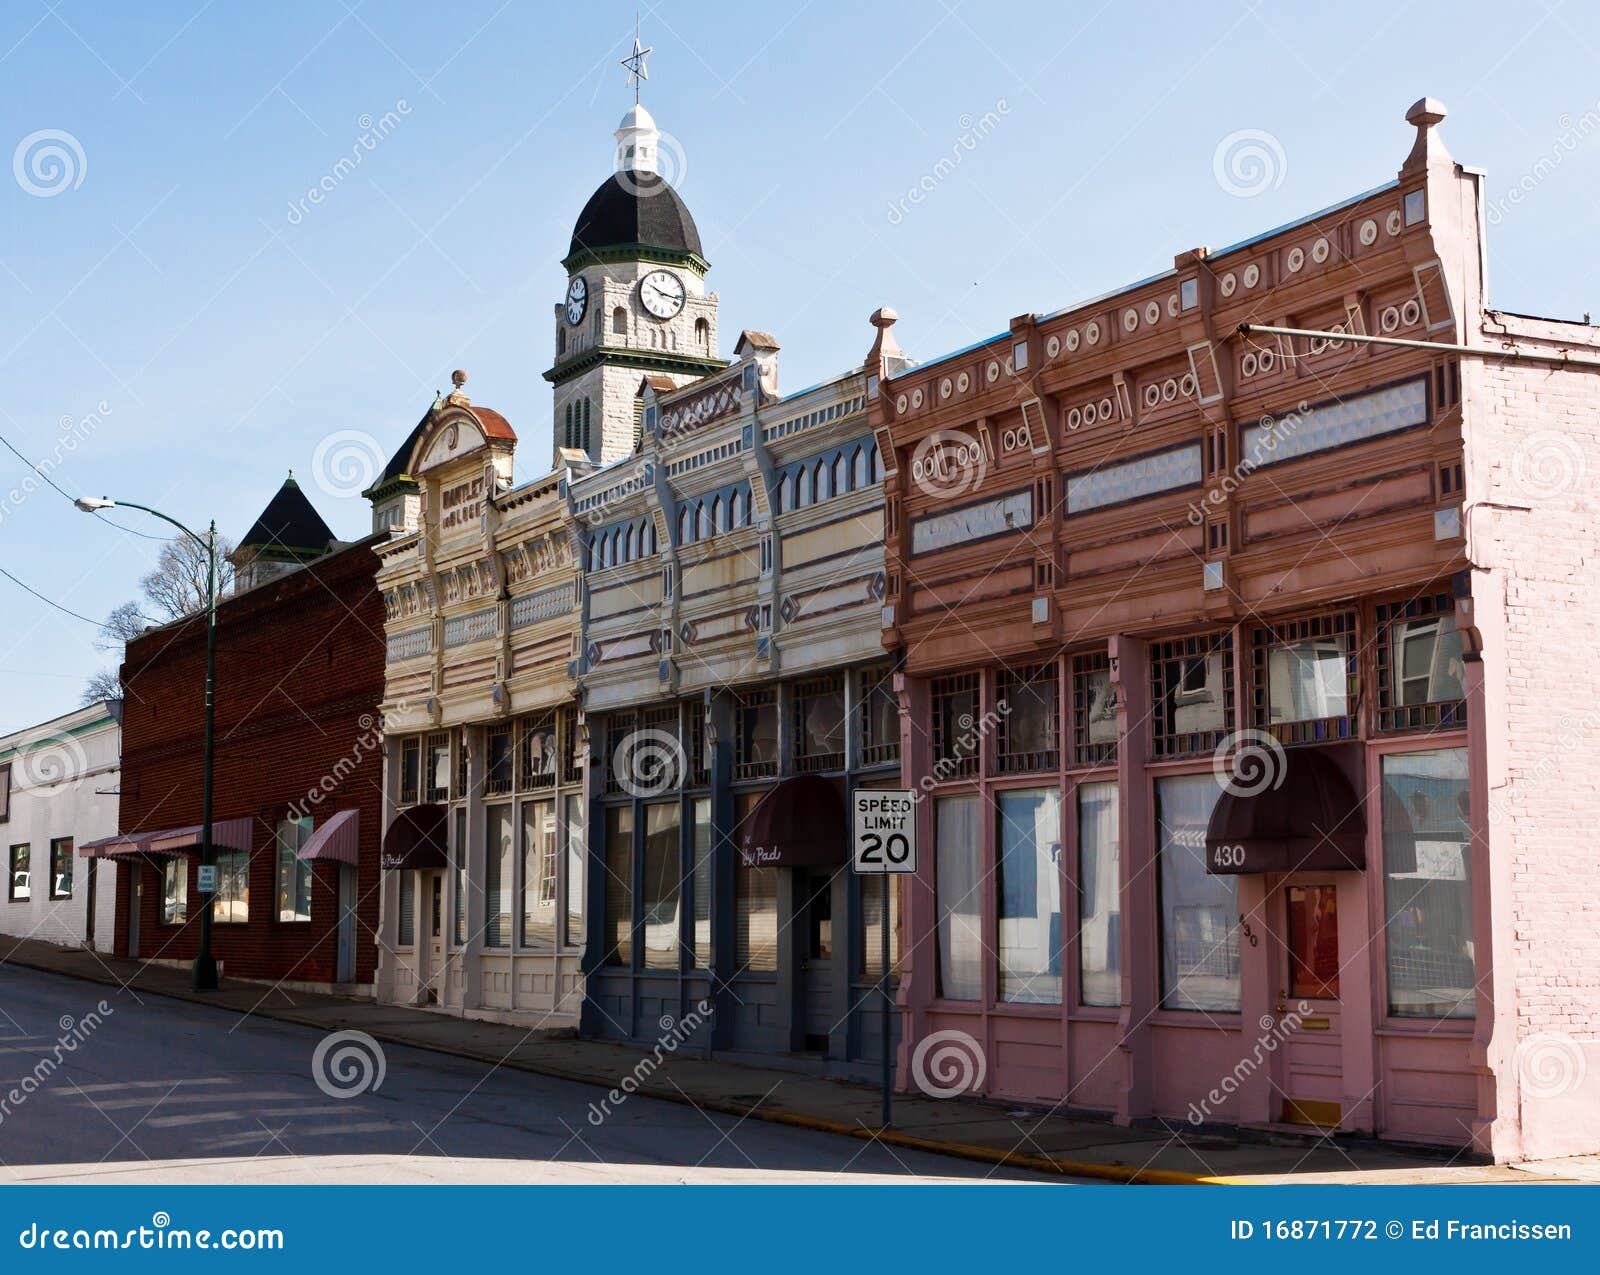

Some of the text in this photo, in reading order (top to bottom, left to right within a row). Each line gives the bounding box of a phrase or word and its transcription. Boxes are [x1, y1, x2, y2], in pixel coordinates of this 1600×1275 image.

[858, 799, 911, 812] SPEED
[864, 816, 906, 830] LIMIT
[860, 833, 910, 864] 20
[1214, 845, 1246, 866] 430
